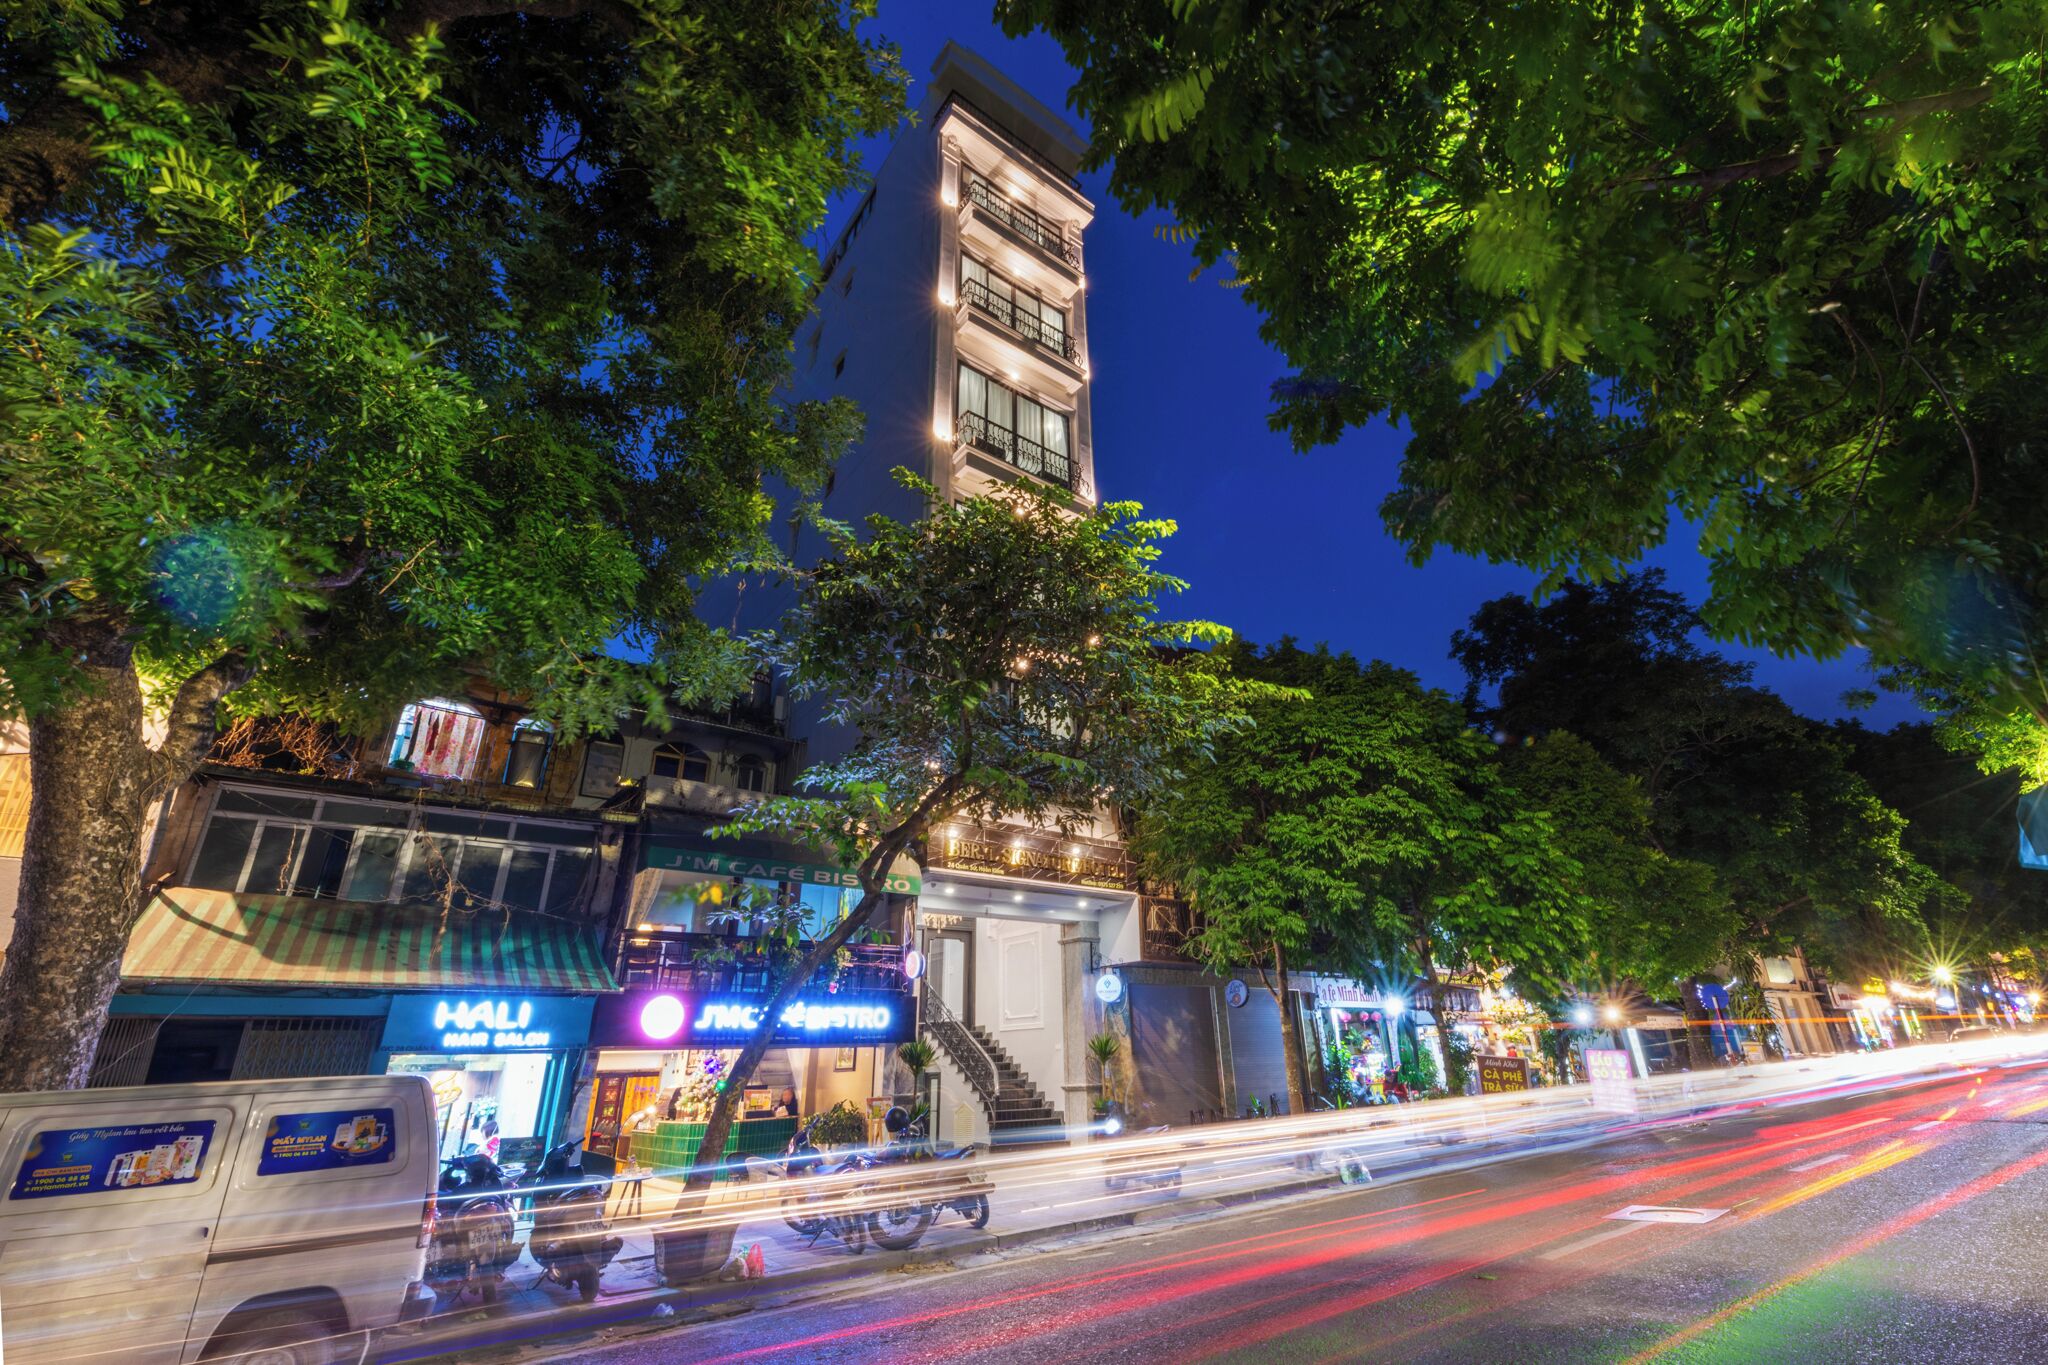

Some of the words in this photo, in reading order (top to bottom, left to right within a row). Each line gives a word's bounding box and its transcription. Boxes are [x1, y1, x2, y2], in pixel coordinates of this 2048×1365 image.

[1001, 847, 1081, 873] SIGNATURE
[729, 861, 805, 880] CAFÉ
[814, 870, 911, 891] BISRO
[1337, 985, 1359, 1002] Minh
[434, 1000, 532, 1030] HALI
[805, 1006, 890, 1030] BISTRO
[443, 1032, 490, 1048] HAIR
[494, 1032, 551, 1047] SALON
[1484, 1058, 1502, 1068] Minh
[1483, 1068, 1500, 1080] CÀ
[1503, 1070, 1524, 1082] PHÊ
[1482, 1080, 1502, 1092] TRÀ
[93, 1128, 122, 1141] Mylan
[296, 1135, 328, 1144] MYLAN
[31, 1182, 90, 1193] mylanmart.vn
